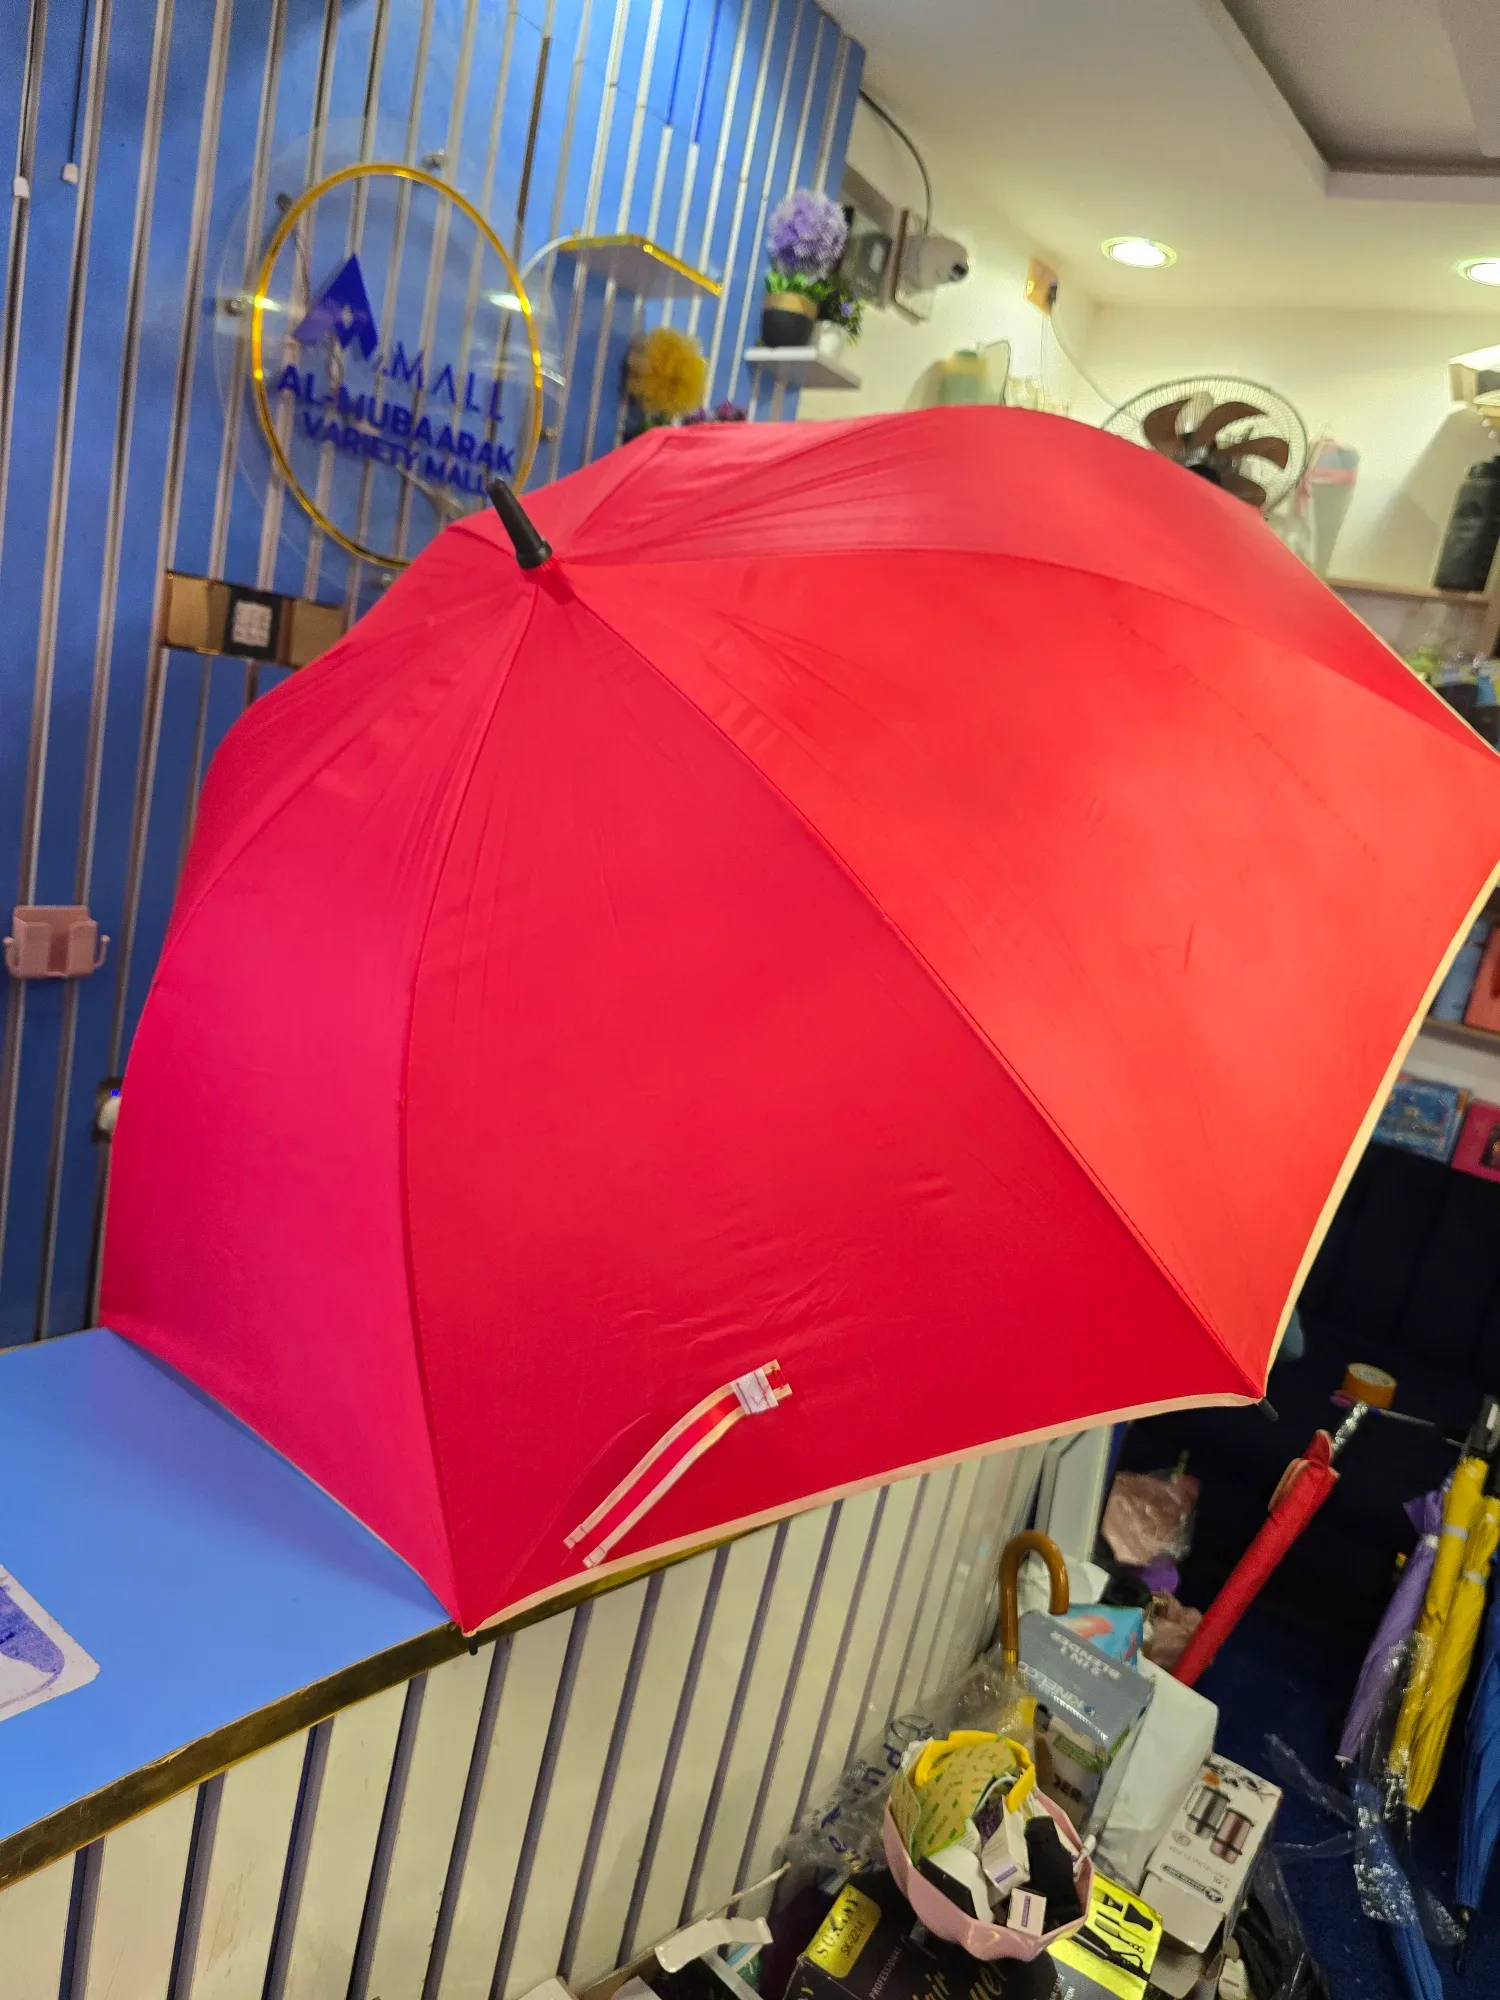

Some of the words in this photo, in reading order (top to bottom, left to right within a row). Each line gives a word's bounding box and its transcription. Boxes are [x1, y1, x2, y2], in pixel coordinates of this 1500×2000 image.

[277, 364, 515, 475] AL-MUBAARAK
[303, 411, 418, 471] VARIETY
[424, 455, 488, 497] MALL
[1050, 1630, 1122, 1680] BLENDER
